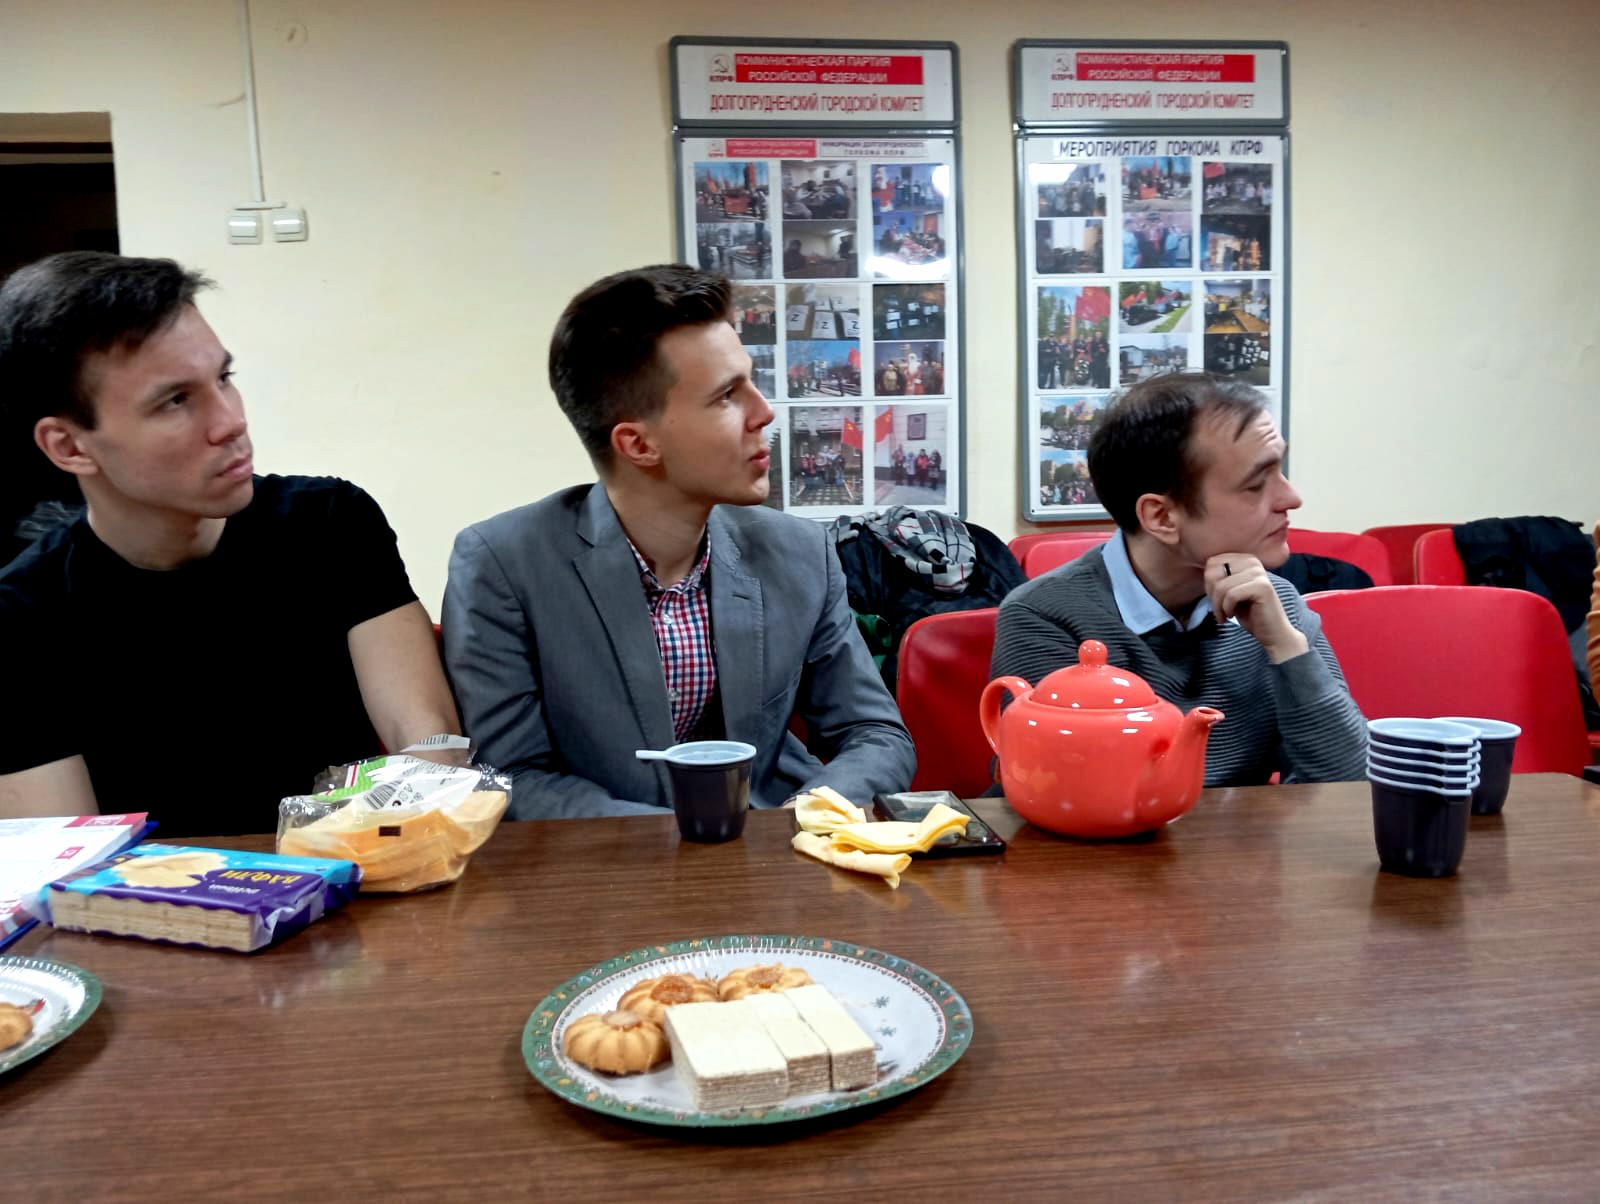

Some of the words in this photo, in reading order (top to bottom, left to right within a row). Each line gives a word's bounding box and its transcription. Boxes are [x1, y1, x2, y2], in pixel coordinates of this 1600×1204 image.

[735, 55, 845, 67] КОММУНИСТИЧЕСКАЯ
[847, 56, 891, 67] ПАРТИЯ
[1077, 54, 1181, 65] КОММУНИСТИЧЕСКАЯ
[1182, 55, 1224, 65] ПАРТИЯ
[748, 70, 816, 81] РОССИЙСКОЙ
[821, 72, 888, 83] ФЕДЕРАЦИИ
[1088, 69, 1153, 80] РОССИЙСКОЙ
[1157, 70, 1221, 81] ФЕДЕРАЦИИ
[711, 93, 817, 112] ДОЛГОПРУДНЕНСКИЙ
[821, 93, 878, 113] ГОРОДСКОЙ
[880, 96, 924, 111] КОМИТЕТ
[1052, 90, 1151, 111] ДОЛГОПРУДНЕНСКИЙ
[1157, 91, 1211, 111] ГОРОДСКОЙ
[1213, 94, 1254, 108] КОМИТЕТ
[1060, 140, 1157, 156] МЕРОПРИЯТИЯ
[1166, 140, 1219, 155] ГОРКОМА
[1230, 140, 1263, 155] КПРФ
[219, 870, 302, 884] ВАФЛИ
